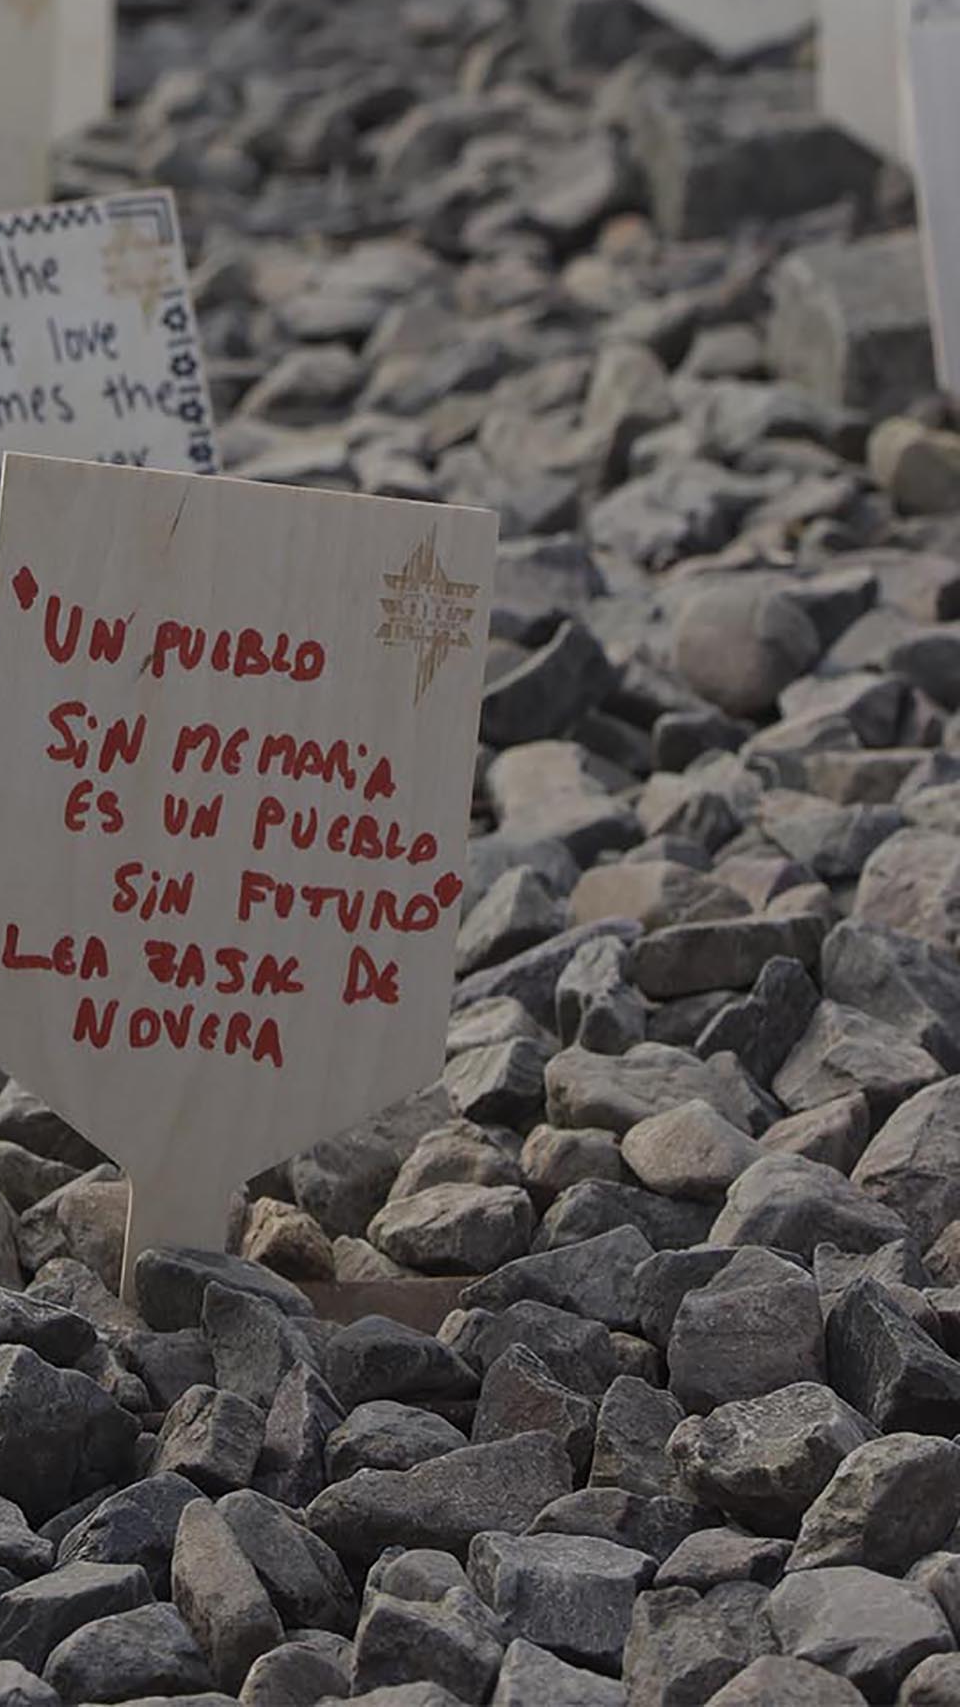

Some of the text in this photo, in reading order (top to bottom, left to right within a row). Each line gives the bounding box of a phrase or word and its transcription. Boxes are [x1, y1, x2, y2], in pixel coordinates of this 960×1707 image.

[48, 317, 120, 362] love
[103, 374, 179, 419] the
[152, 621, 326, 682] PUEBLO
[65, 780, 437, 865] ES UN PUEBLO
[2, 924, 109, 979] LEA
[342, 946, 401, 1005] DE
[72, 996, 284, 1068] NOVERA
